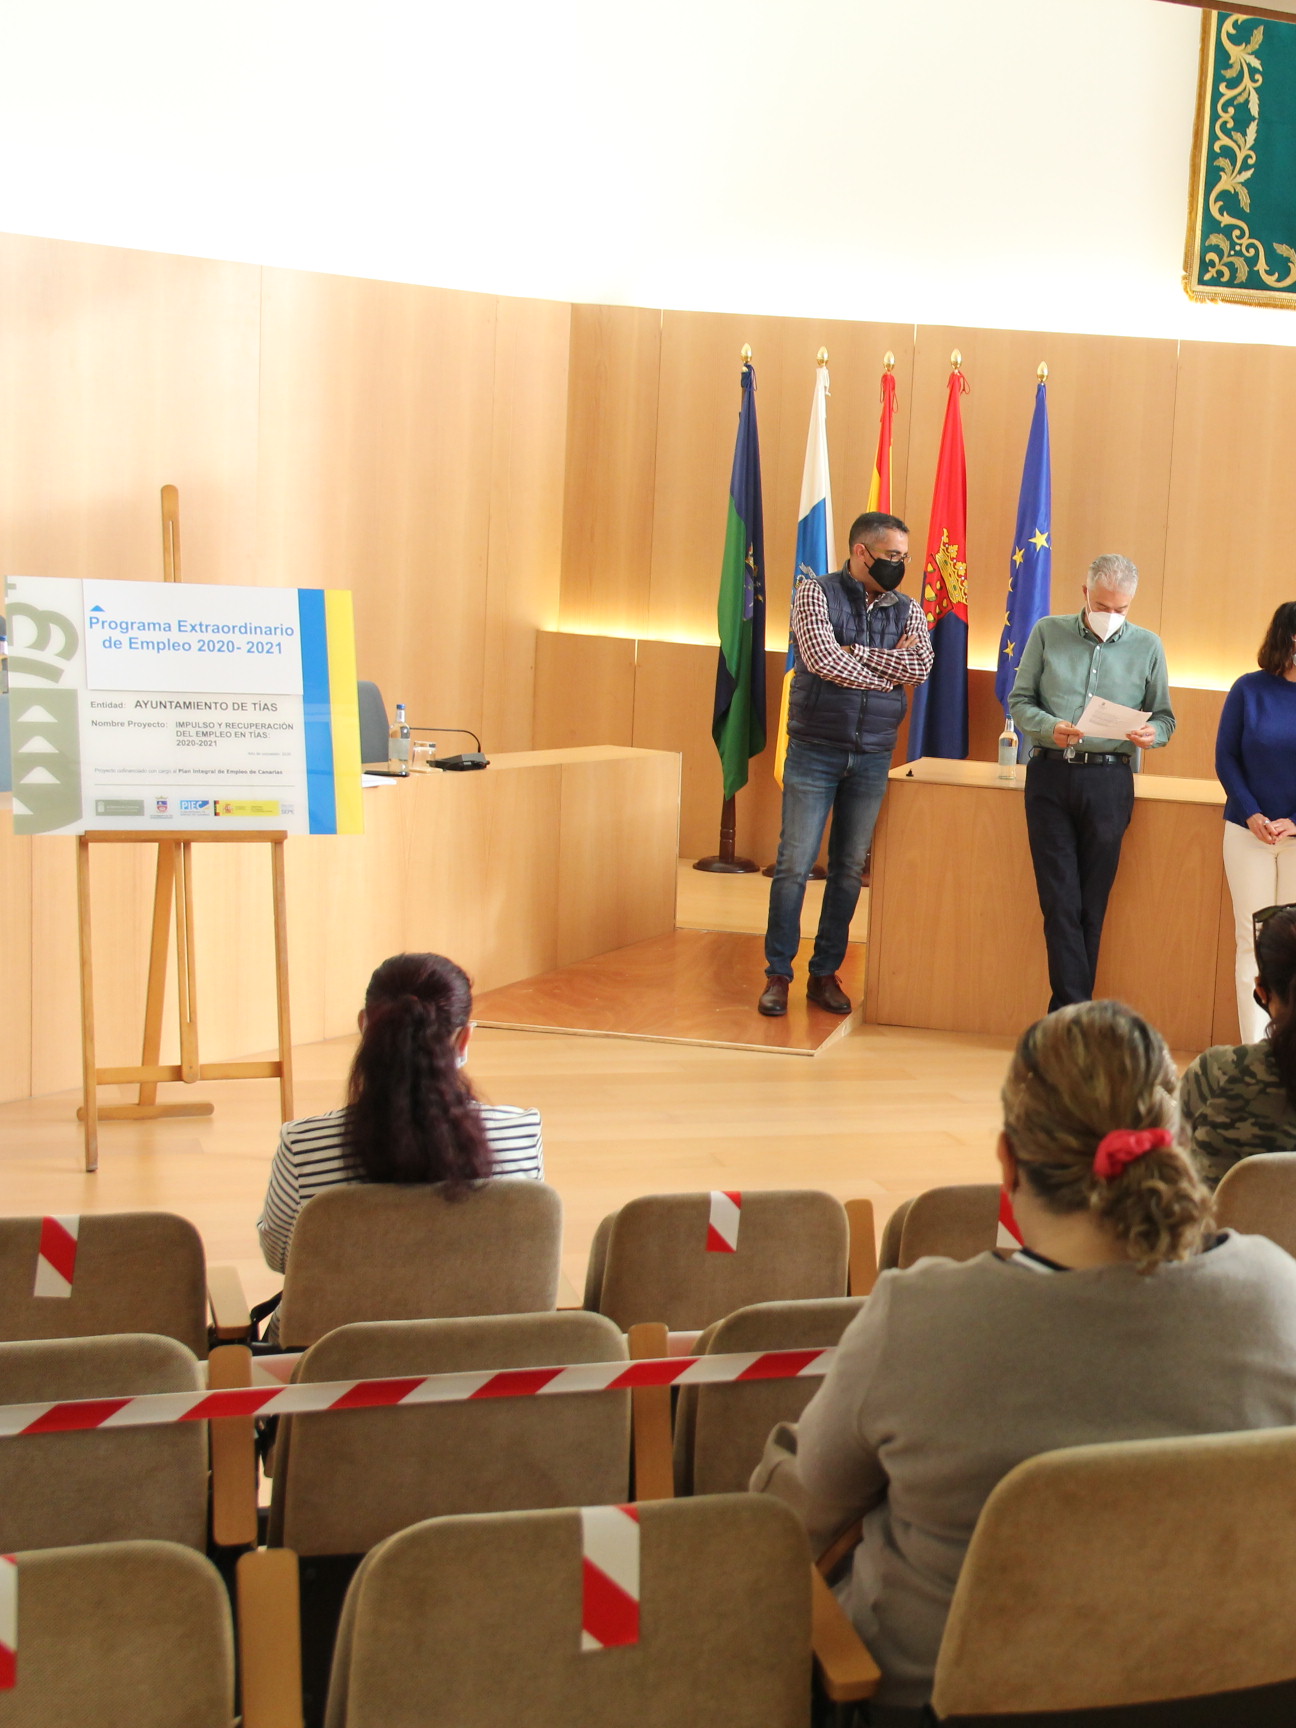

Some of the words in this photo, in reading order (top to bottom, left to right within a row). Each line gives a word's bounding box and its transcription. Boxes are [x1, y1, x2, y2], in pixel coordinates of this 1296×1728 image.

[89, 616, 172, 634] Programa
[177, 619, 294, 636] Extraordinario
[102, 636, 122, 649] de
[128, 637, 192, 653] Empleo
[197, 639, 242, 653] 2020-
[246, 641, 282, 654] 2021
[90, 701, 126, 709] Entidad:
[134, 700, 229, 711] AYUNTAMIENTO
[232, 702, 248, 711] DE
[251, 701, 278, 712] TÍAS
[127, 720, 168, 729] Proyecto:
[175, 721, 215, 729] IMPULSO
[225, 721, 294, 730] RECUPERACIÓN
[176, 730, 193, 738] DEL
